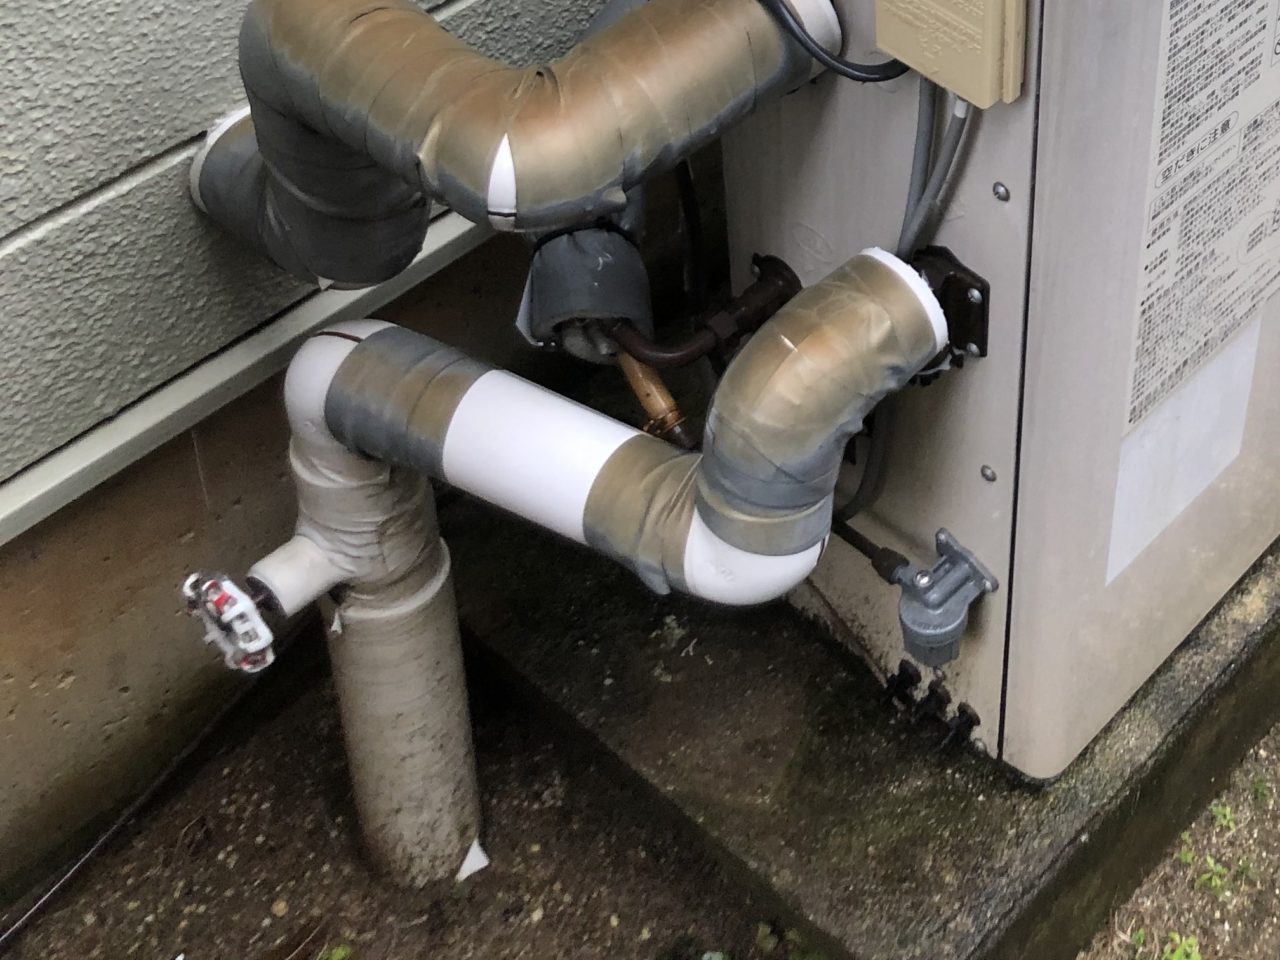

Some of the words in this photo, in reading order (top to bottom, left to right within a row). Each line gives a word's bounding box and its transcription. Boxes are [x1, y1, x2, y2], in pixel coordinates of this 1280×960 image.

[1160, 116, 1231, 185] 空だきに注意
